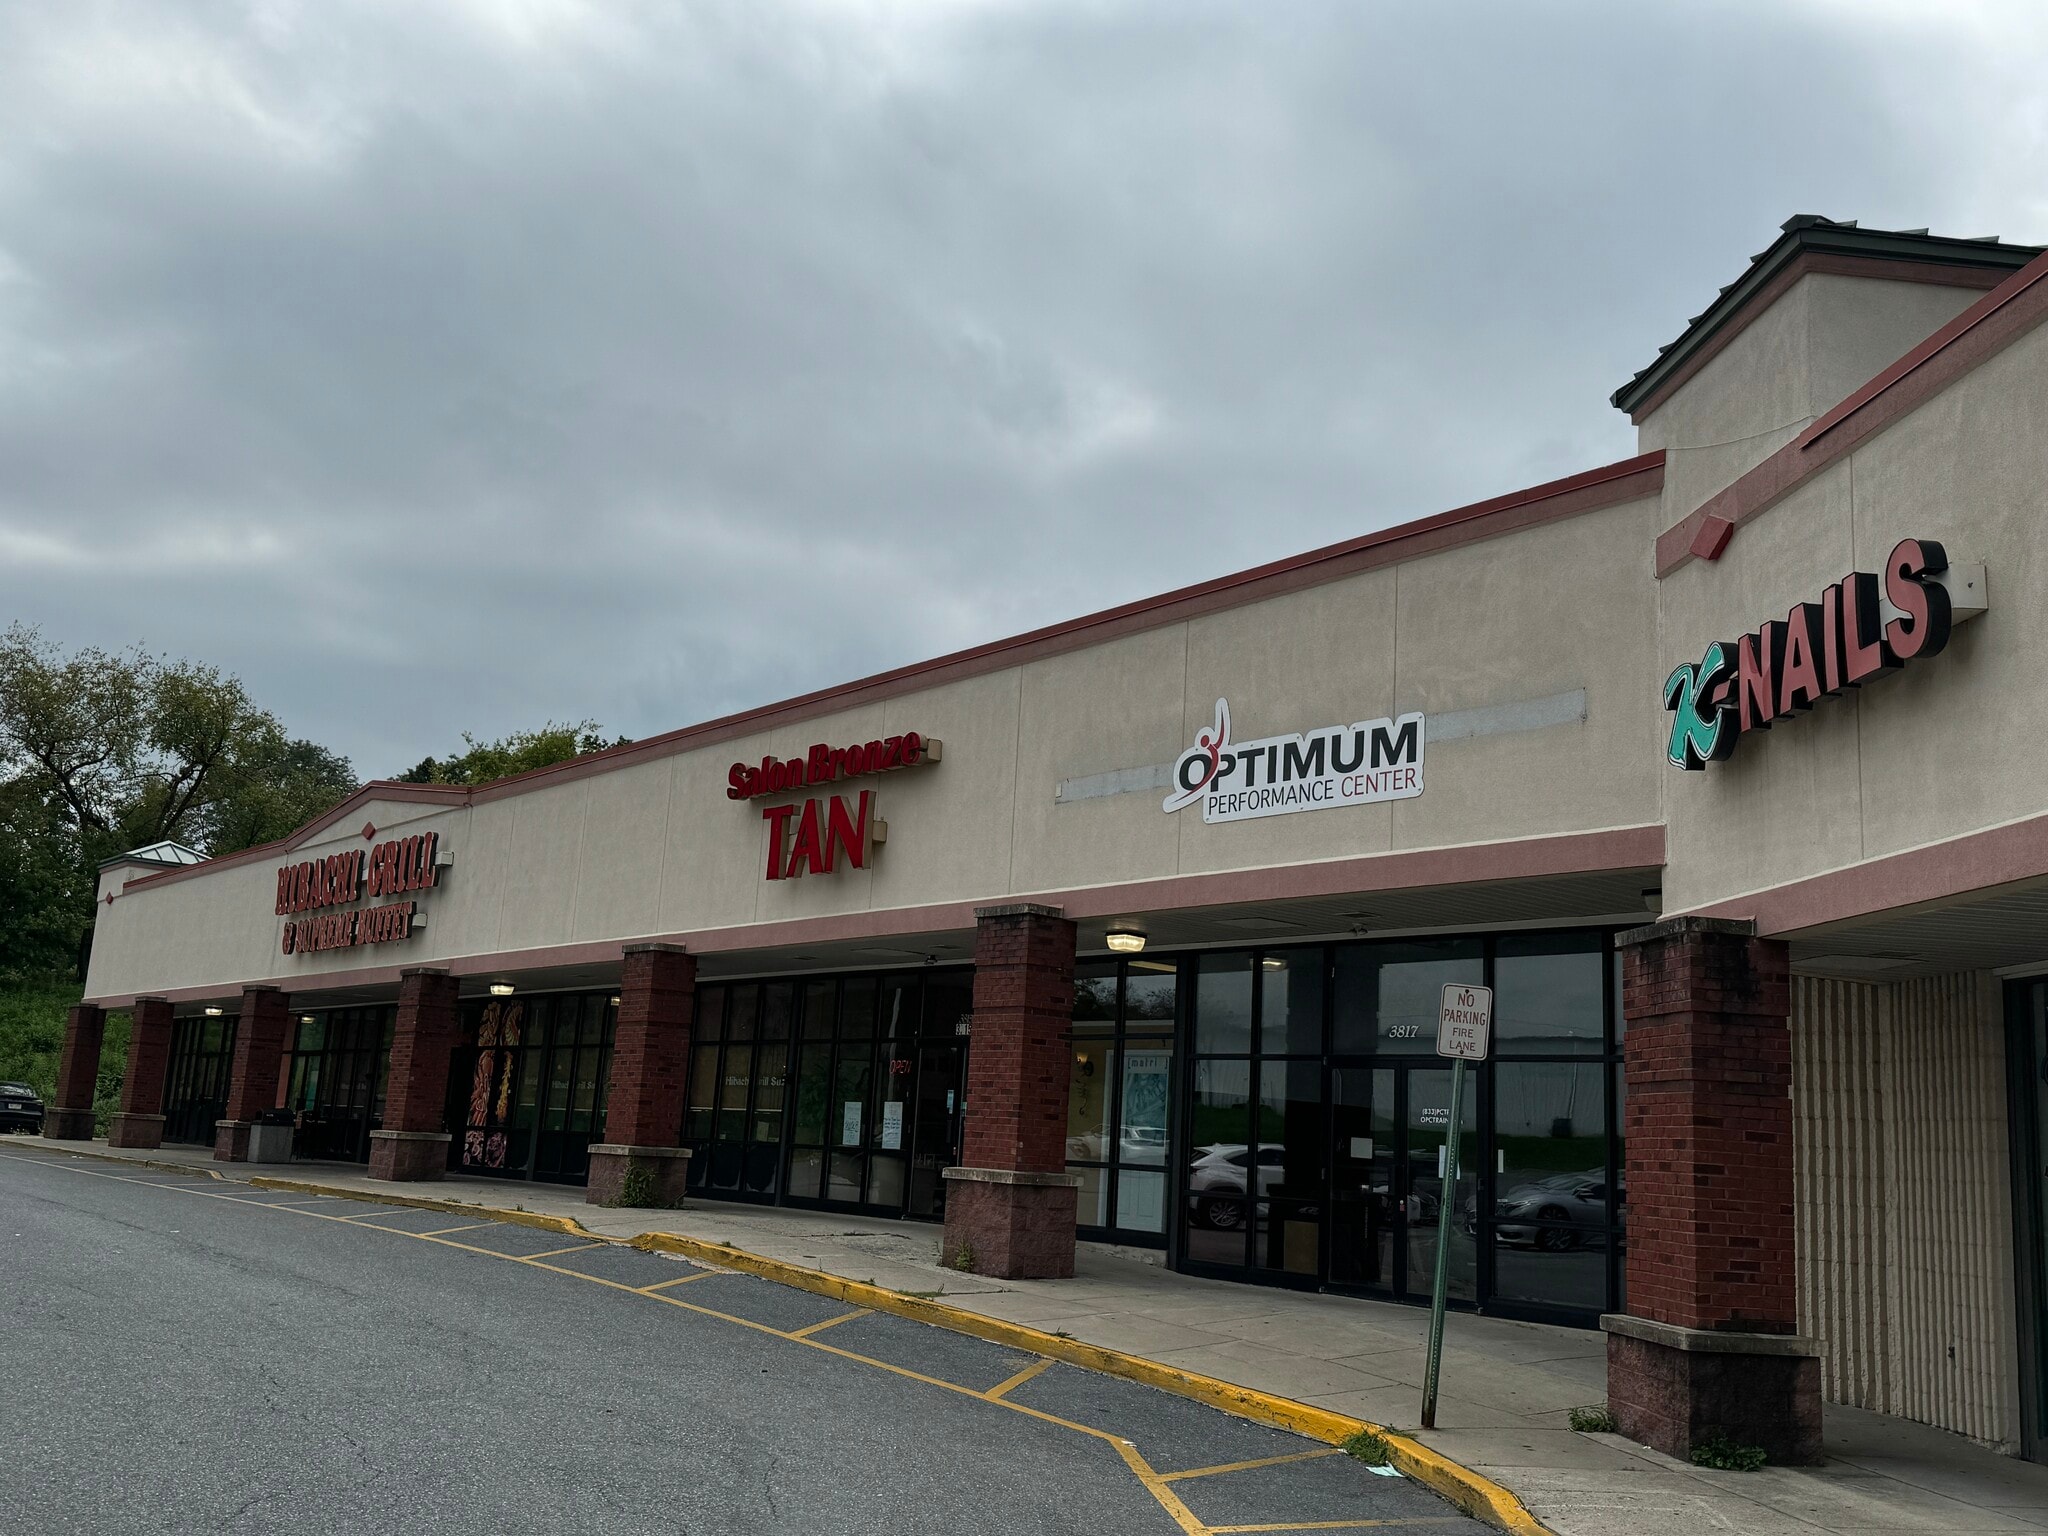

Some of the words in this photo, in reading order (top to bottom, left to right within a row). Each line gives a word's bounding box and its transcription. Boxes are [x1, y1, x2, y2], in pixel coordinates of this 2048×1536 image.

[727, 756, 804, 800] Salon
[806, 731, 927, 784] Bronze
[1178, 721, 1418, 793] OPTIMUM
[1208, 779, 1334, 815] PERFORMANCE
[1341, 767, 1416, 798] CENTER
[763, 789, 876, 881] TAN
[275, 849, 365, 915] HIBACHI
[366, 831, 440, 897] GRILL
[295, 911, 359, 953] SUPREME
[356, 901, 417, 945] BUFFET
[1457, 993, 1475, 1008] NO
[1443, 1008, 1486, 1026] PARKING
[1389, 1025, 1419, 1038] 3817
[1452, 1027, 1474, 1039] FIRE
[1449, 1040, 1476, 1052] LANE
[889, 1059, 913, 1075] OPEN
[725, 1076, 749, 1086] Hibach
